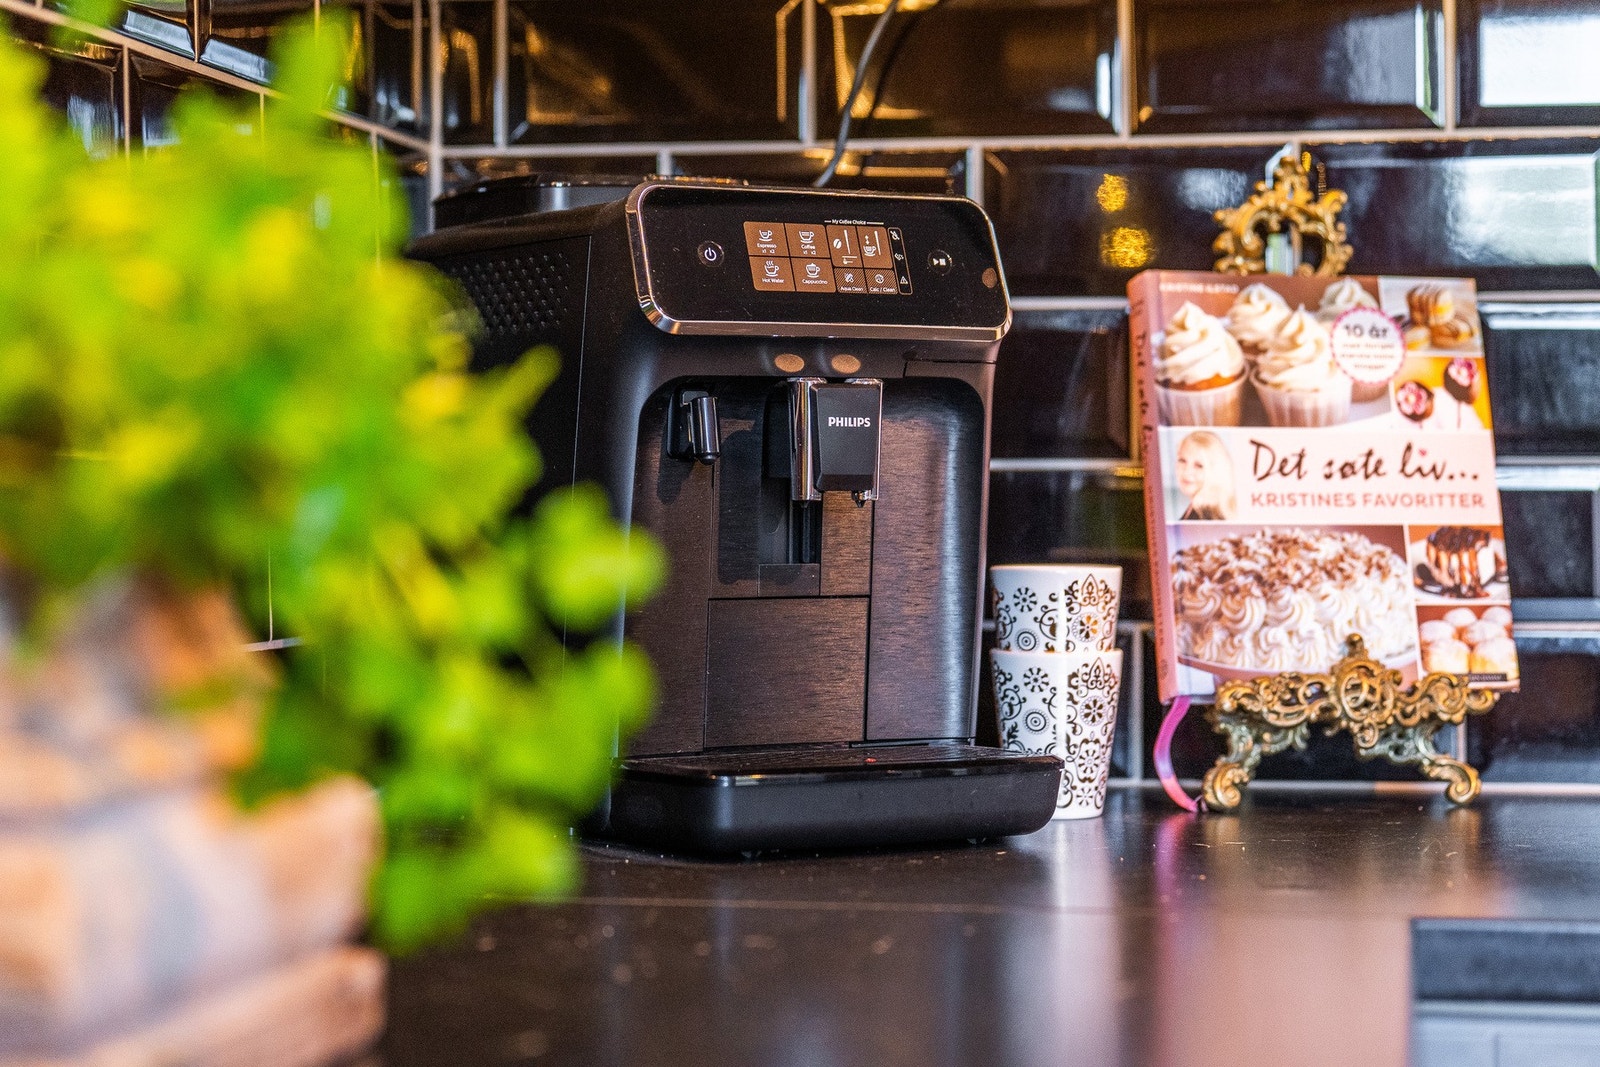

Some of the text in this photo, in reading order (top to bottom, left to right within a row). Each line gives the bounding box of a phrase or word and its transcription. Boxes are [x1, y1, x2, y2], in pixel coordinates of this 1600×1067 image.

[1344, 322, 1388, 338] 10 år
[828, 416, 871, 428] PHILIPS
[1250, 439, 1308, 481] Det
[1251, 492, 1486, 508] KRISTINES FAVORITTER
